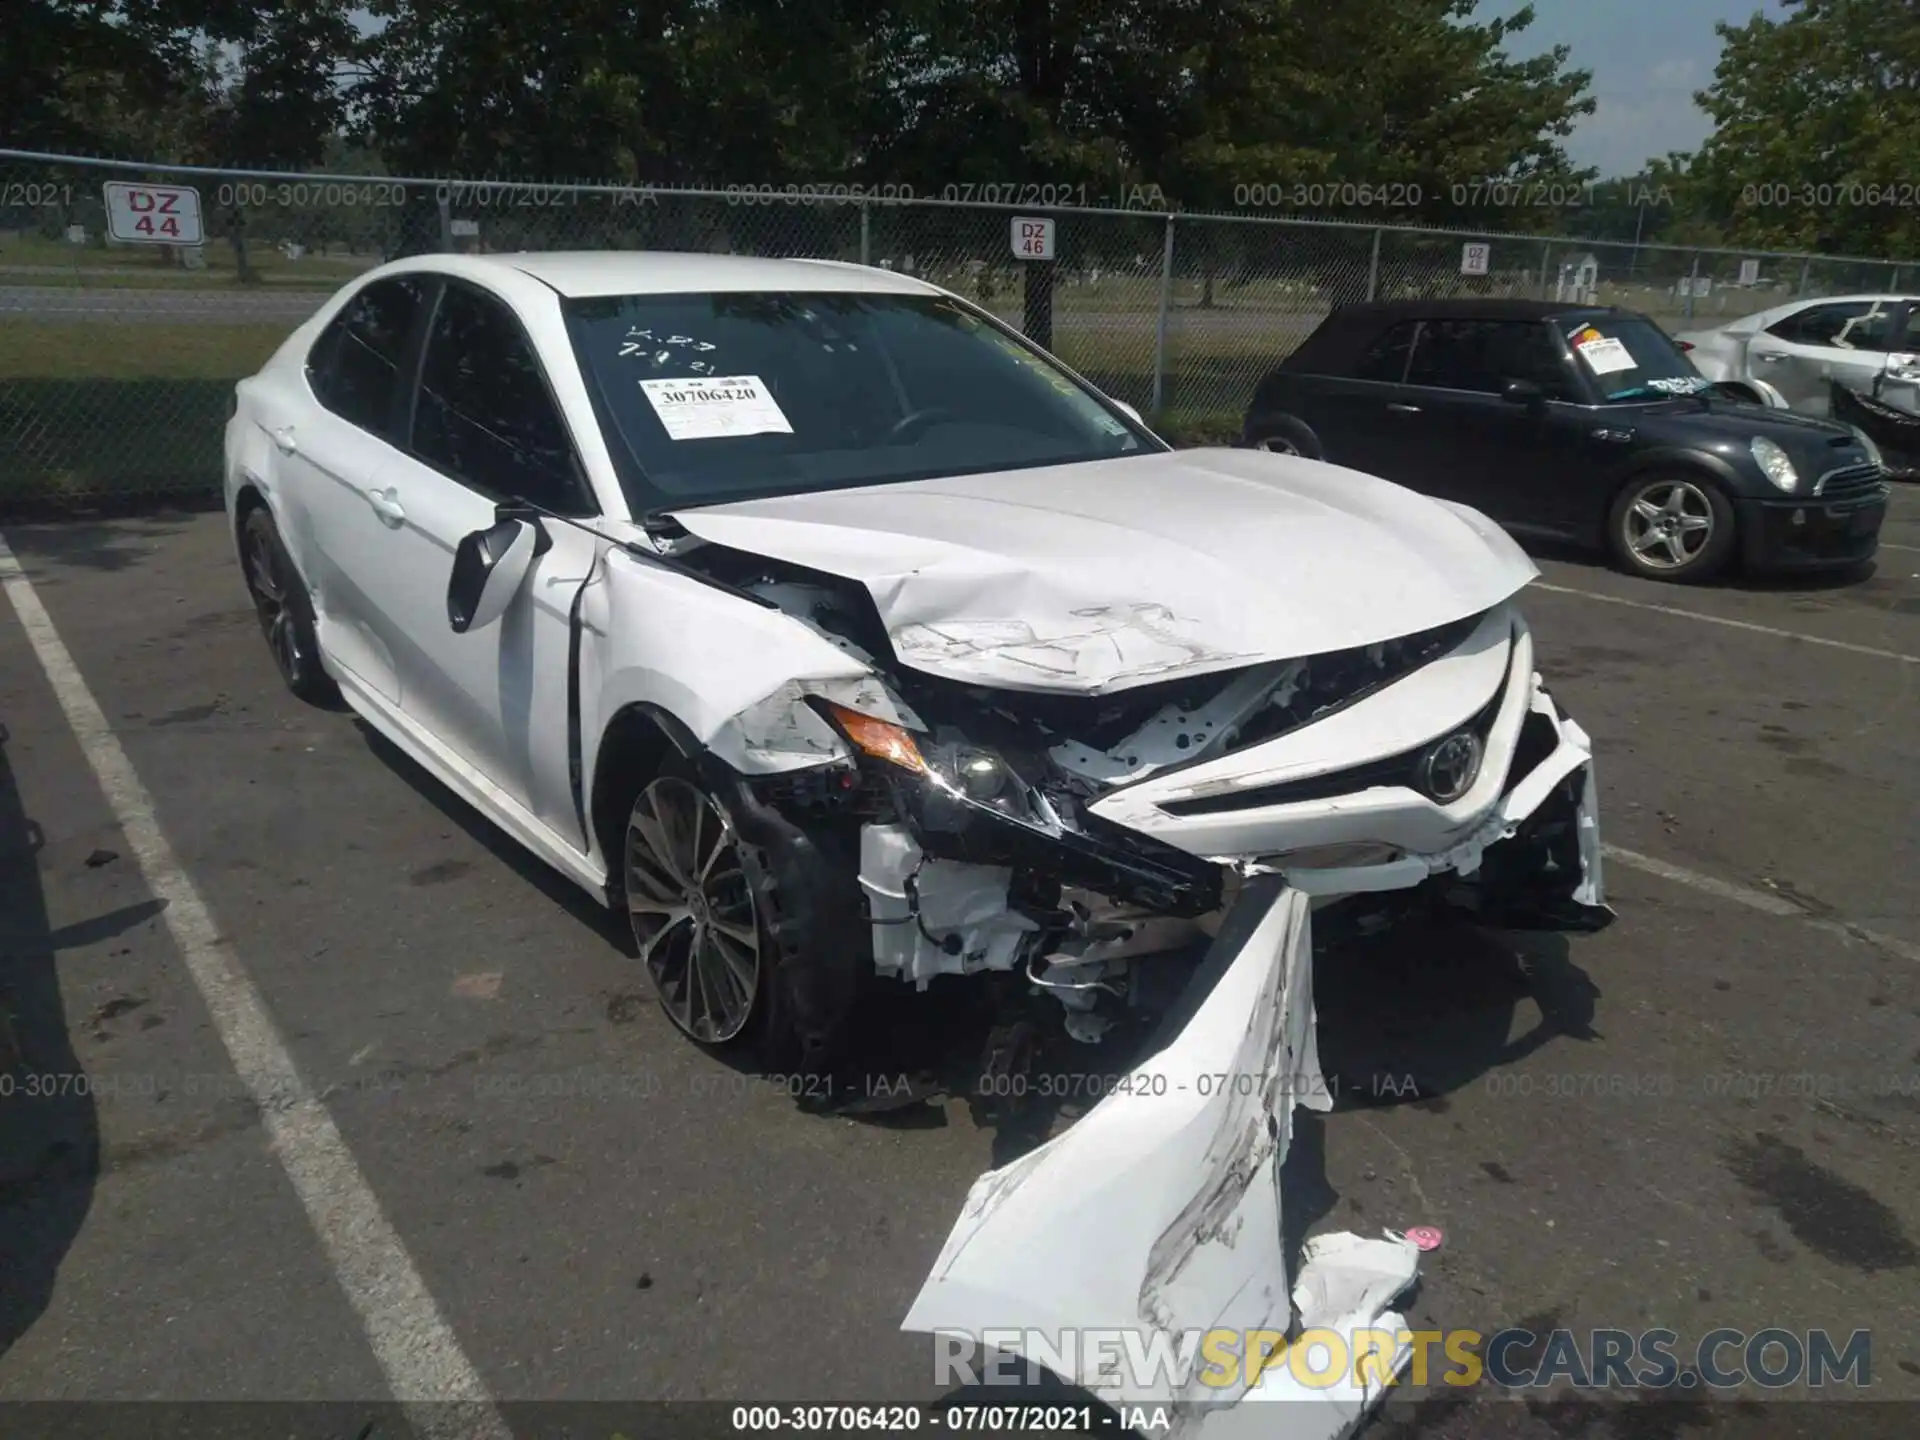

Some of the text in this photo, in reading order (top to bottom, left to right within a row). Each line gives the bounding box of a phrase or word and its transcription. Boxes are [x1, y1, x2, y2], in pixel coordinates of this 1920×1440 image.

[128, 190, 182, 214] DZ
[134, 215, 182, 238] 44
[1021, 223, 1045, 238] DZ
[1022, 239, 1044, 255] 46
[660, 388, 757, 404] 30706420
